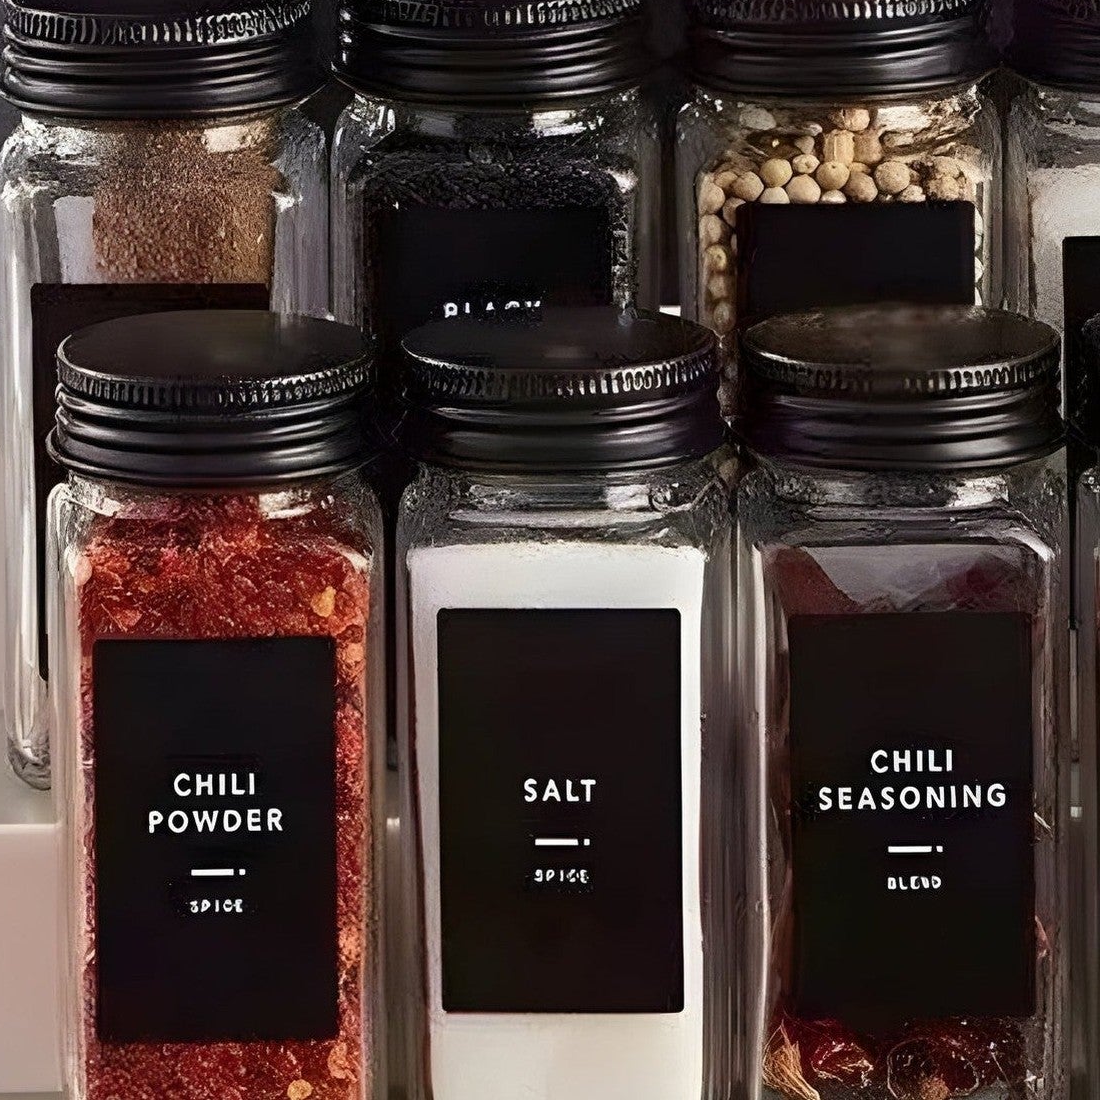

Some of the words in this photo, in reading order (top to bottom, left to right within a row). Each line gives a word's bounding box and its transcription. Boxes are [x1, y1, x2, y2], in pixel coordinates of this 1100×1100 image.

[870, 749, 953, 773] CHILI
[173, 772, 255, 797] CHILI
[523, 778, 597, 802] SALT
[818, 783, 1007, 810] SEASONING
[148, 808, 283, 834] POWDER
